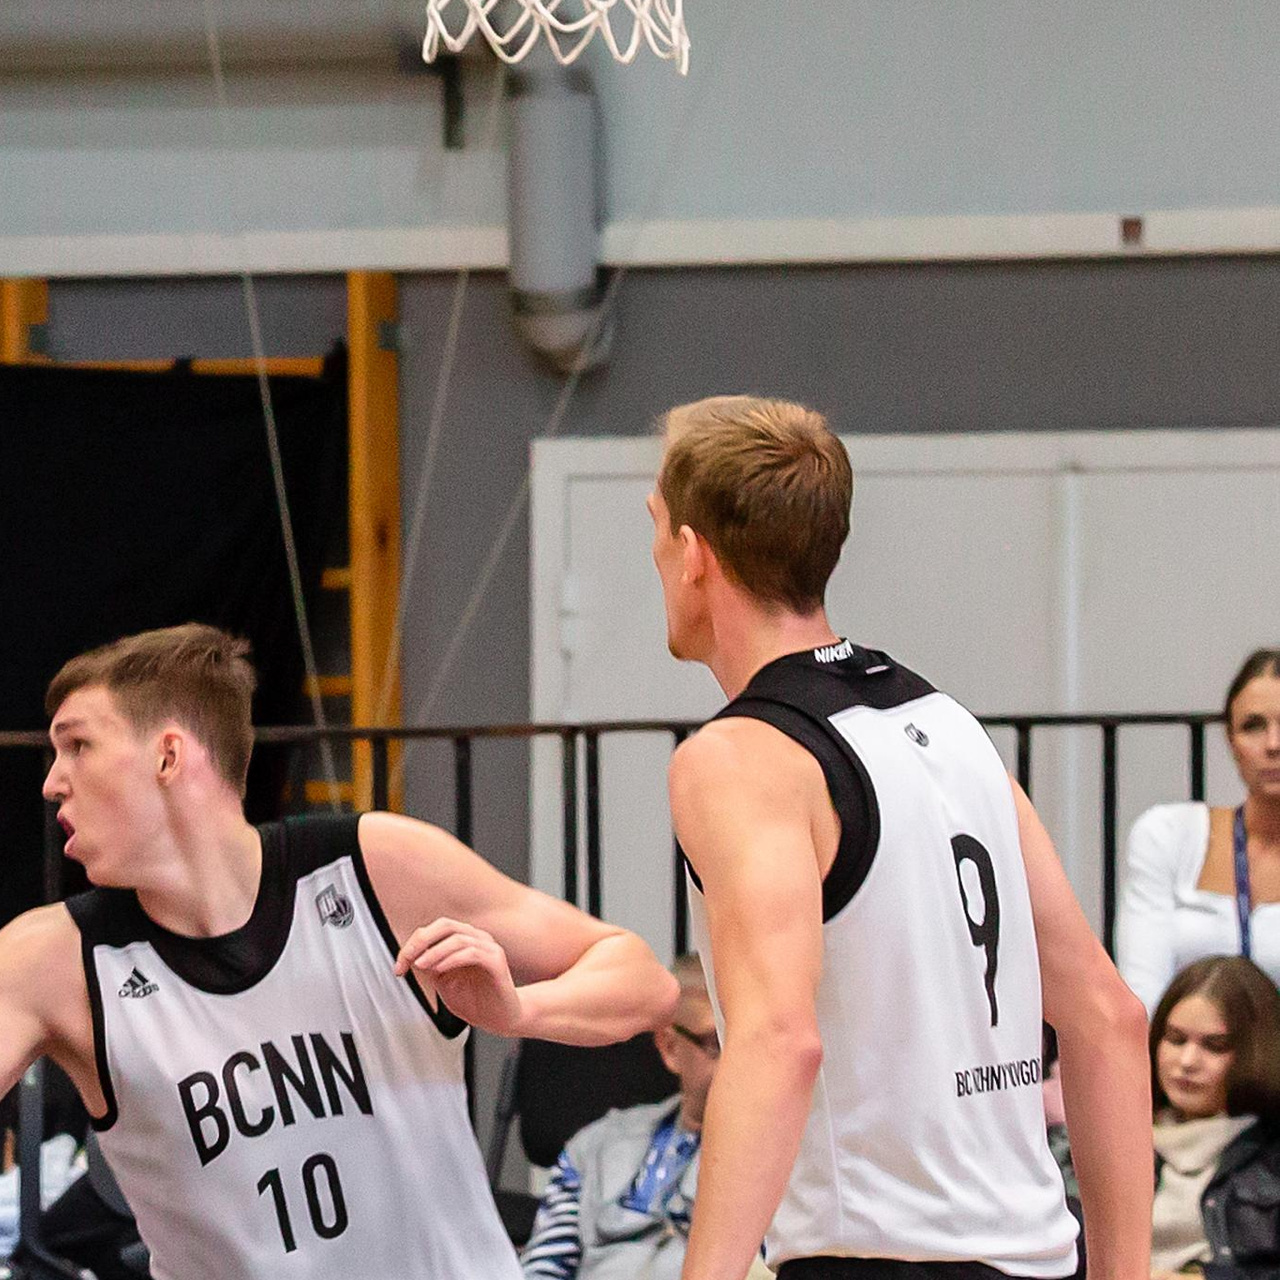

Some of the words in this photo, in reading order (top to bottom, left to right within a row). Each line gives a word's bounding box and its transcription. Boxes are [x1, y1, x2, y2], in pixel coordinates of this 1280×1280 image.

[949, 833, 1001, 1028] 9
[177, 1031, 374, 1167] BCNN
[955, 1069, 972, 1097] BC
[256, 1152, 349, 1253] 10
